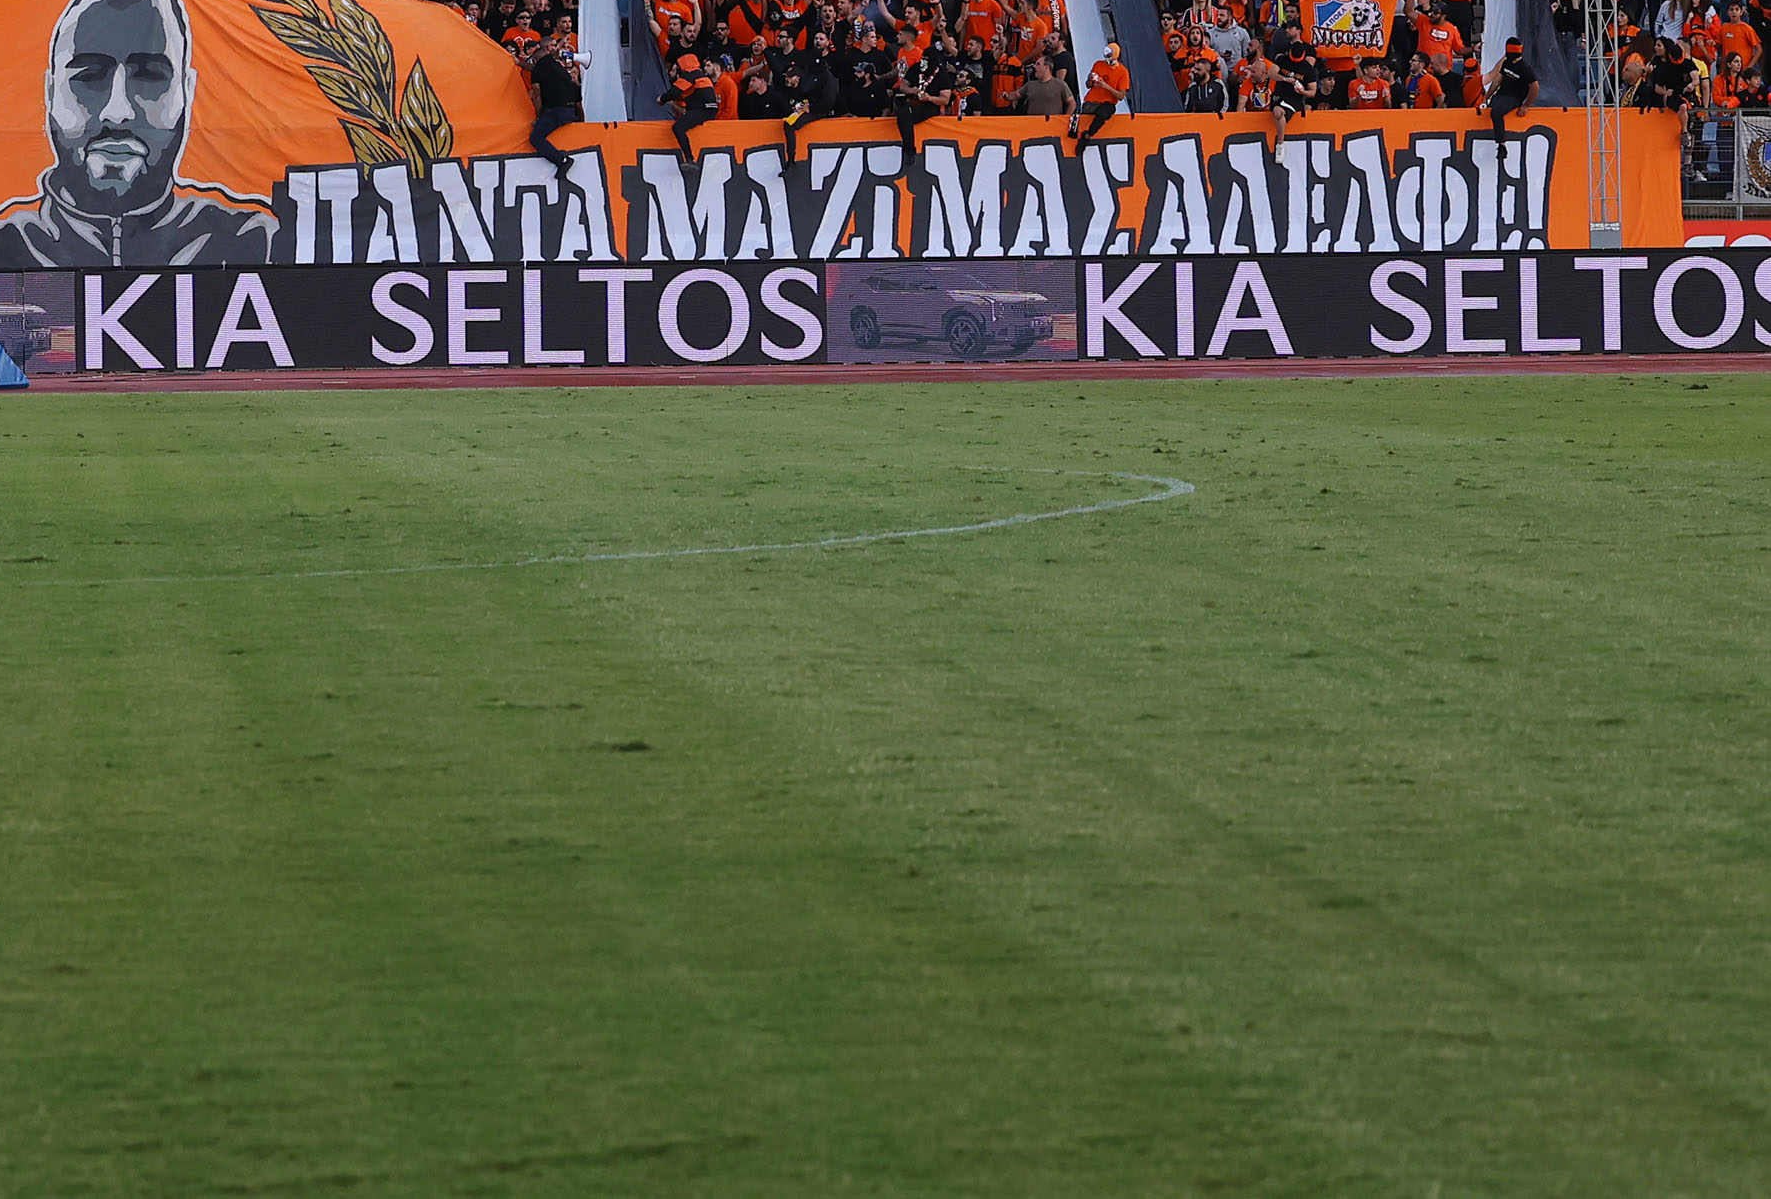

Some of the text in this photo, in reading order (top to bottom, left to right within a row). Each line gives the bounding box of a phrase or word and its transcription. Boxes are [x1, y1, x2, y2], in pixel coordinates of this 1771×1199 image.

[1311, 26, 1384, 50] NICOSIA
[288, 151, 625, 263] ΠΑΝΤΑ
[921, 143, 1130, 259] ΜΑΣ
[84, 268, 823, 370] KIA SELTOS
[1084, 256, 1771, 357] KIA SELTO
